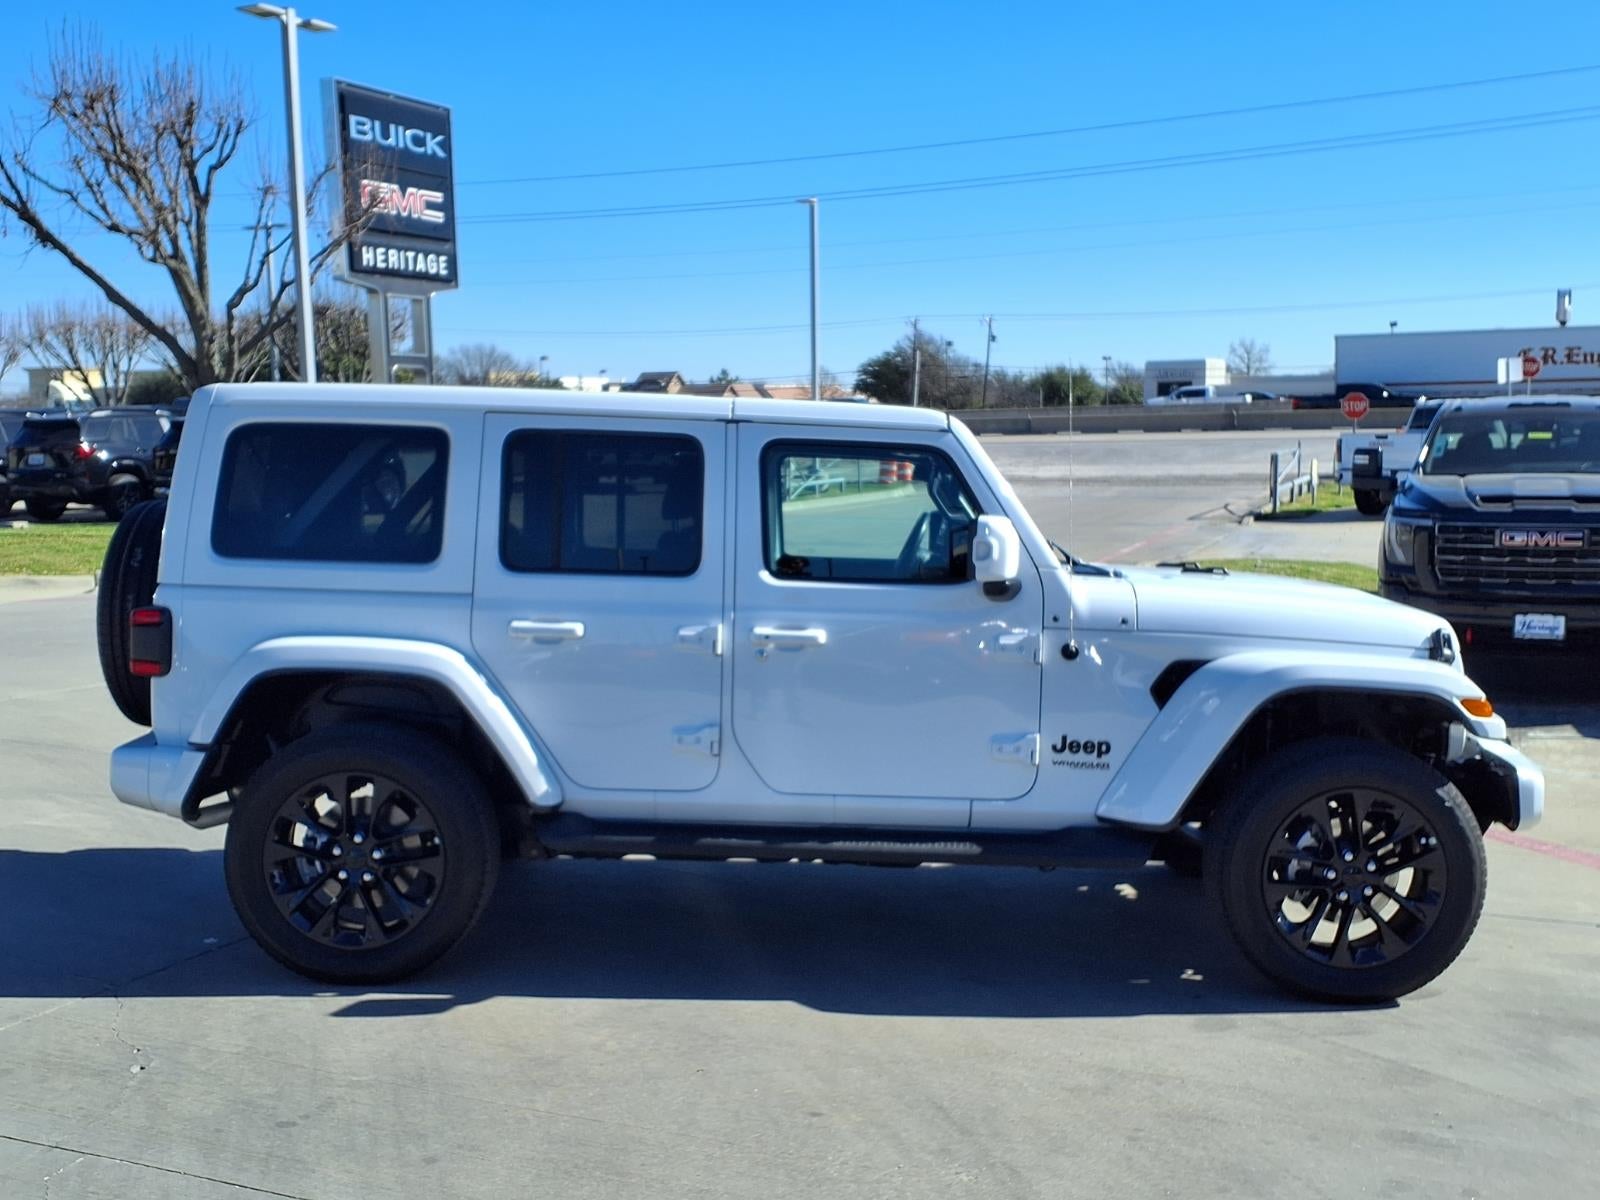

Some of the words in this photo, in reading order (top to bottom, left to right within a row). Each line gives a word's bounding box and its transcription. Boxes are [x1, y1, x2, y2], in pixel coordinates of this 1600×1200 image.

[349, 114, 446, 158] BUICK
[360, 179, 445, 222] GMC
[361, 246, 449, 274] HERITAGE
[1343, 400, 1366, 411] STOP
[1502, 531, 1585, 547] GMC
[1051, 734, 1111, 758] Jeep
